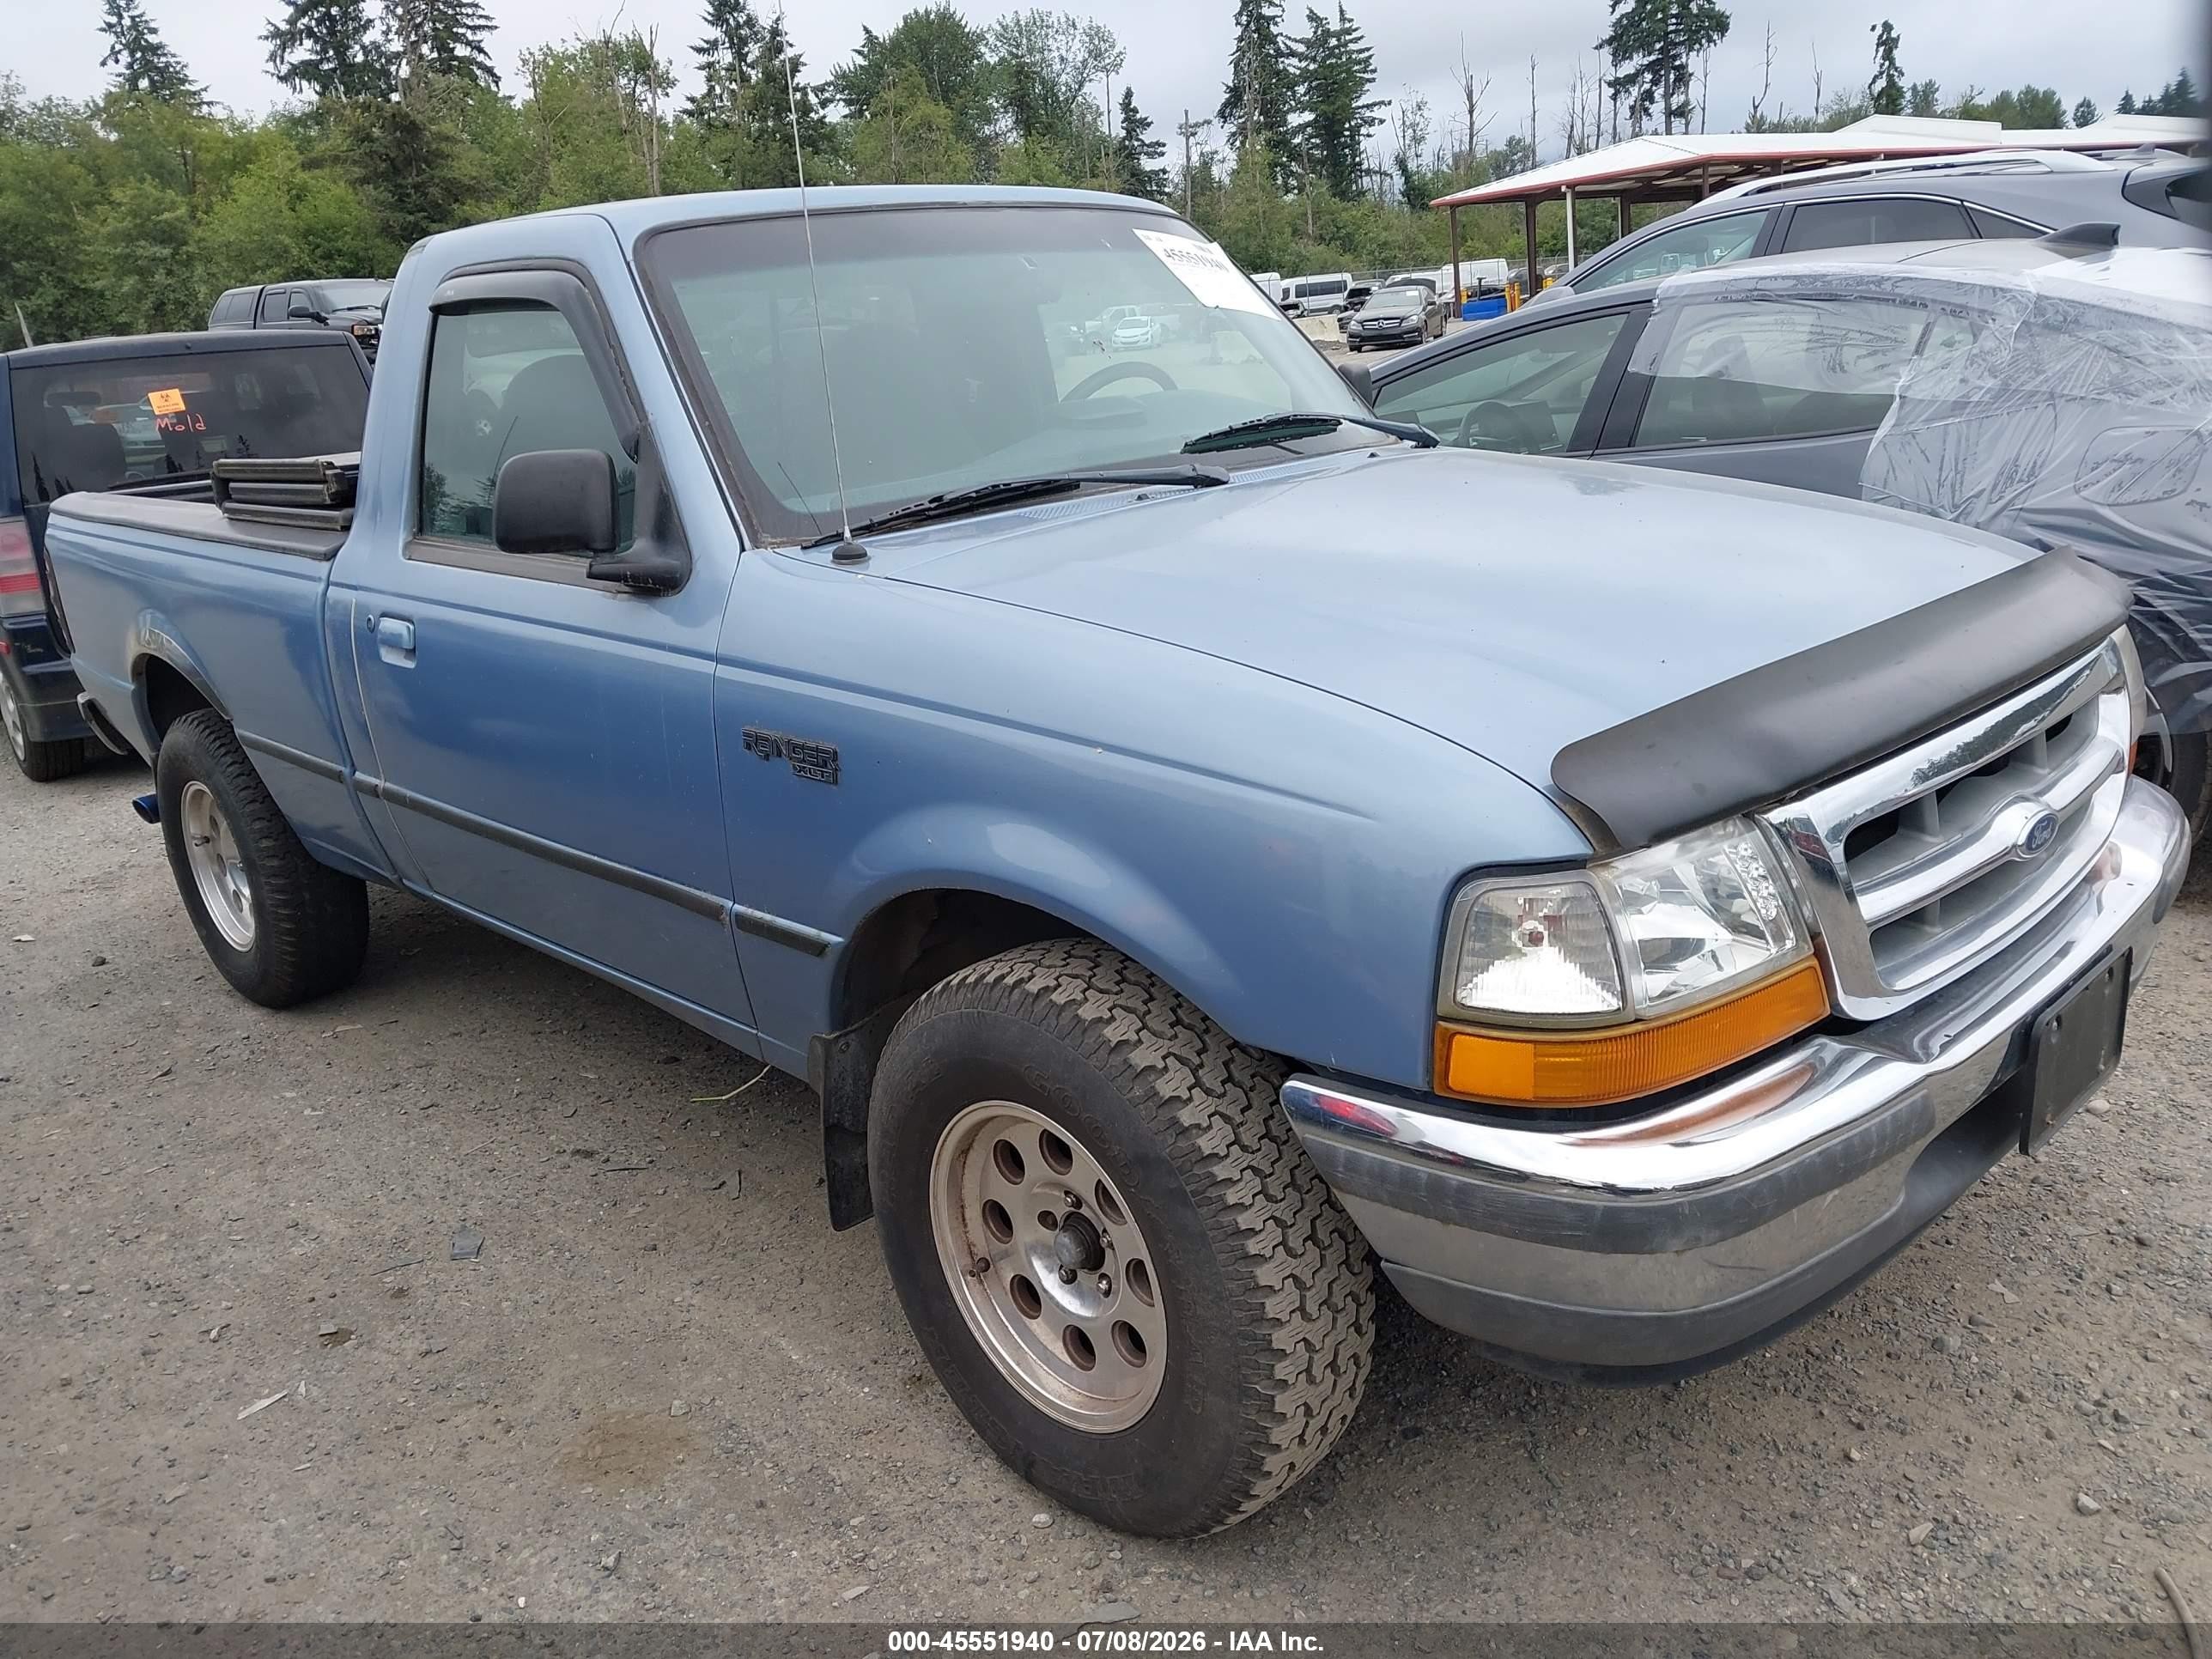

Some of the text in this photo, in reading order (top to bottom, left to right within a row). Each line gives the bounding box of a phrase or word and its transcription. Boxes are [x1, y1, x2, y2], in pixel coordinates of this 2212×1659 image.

[155, 413, 207, 432] Mold
[741, 727, 841, 771] RANGER
[795, 763, 833, 782] XLT
[2031, 820, 2053, 849] Ford
